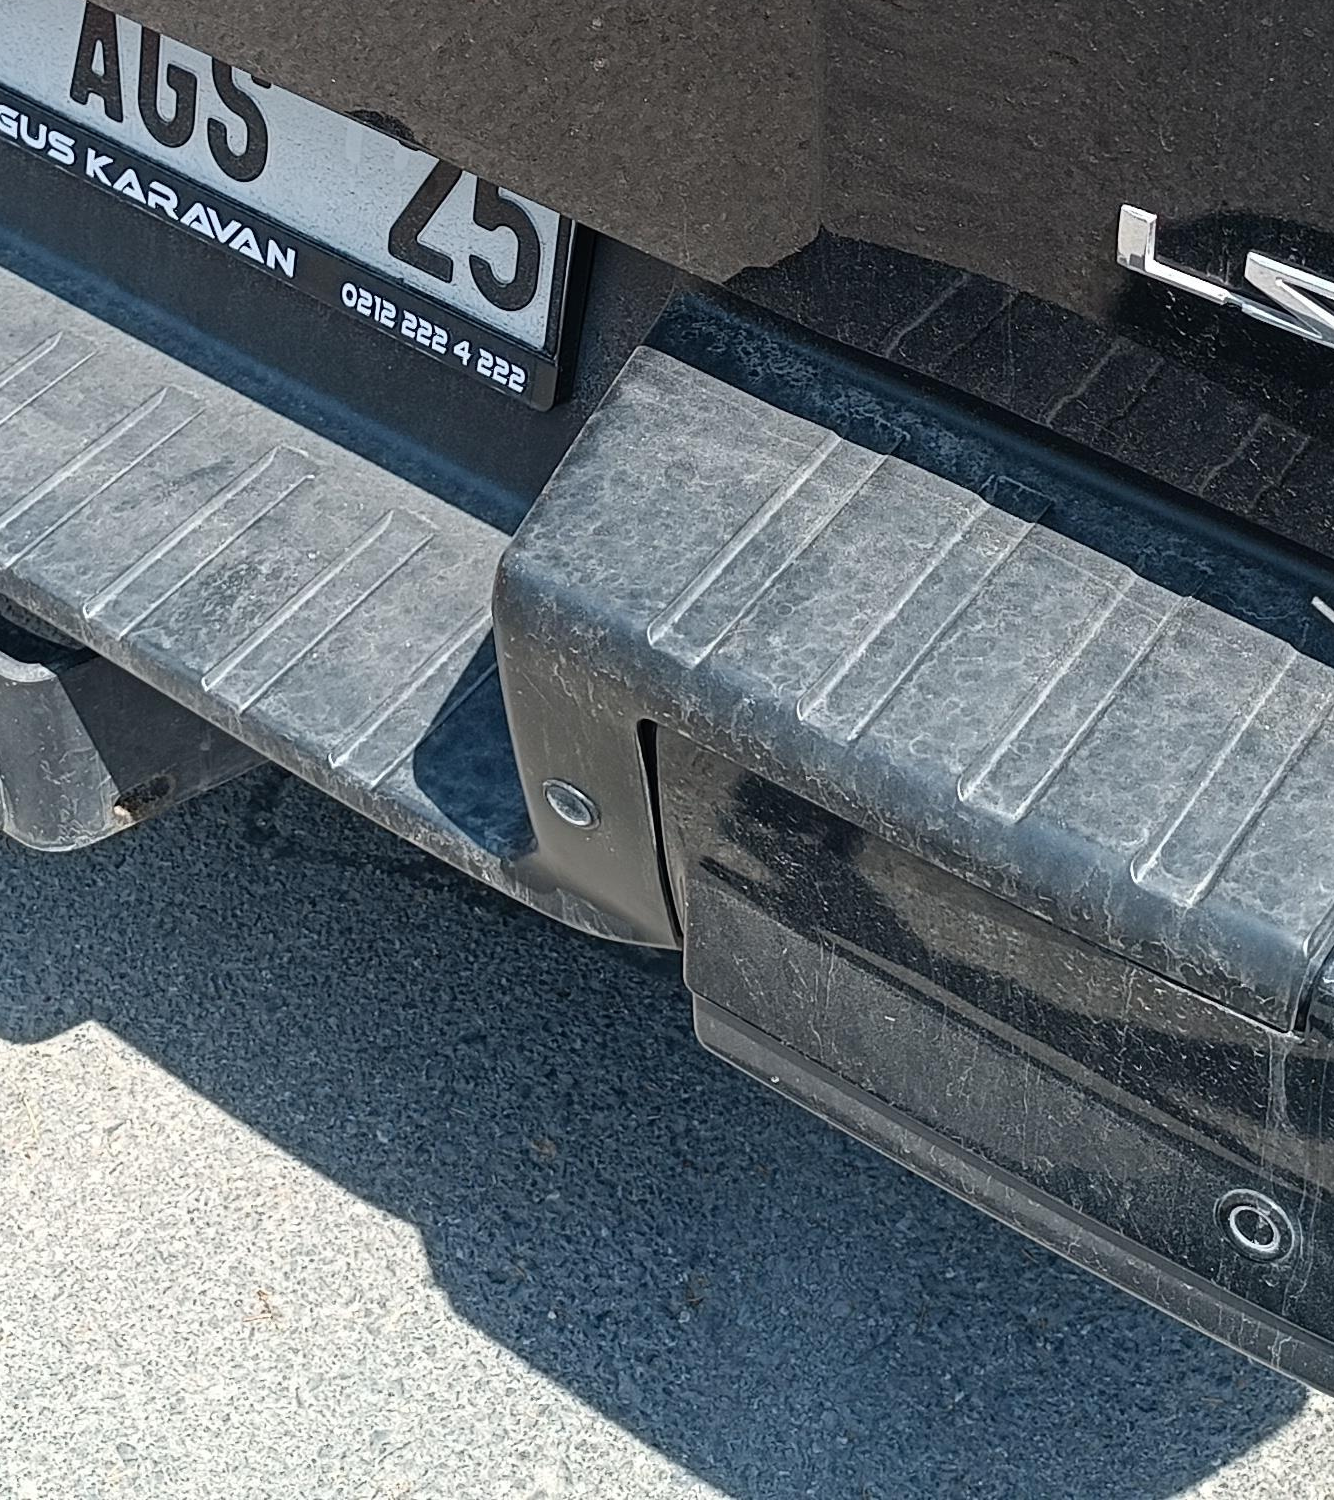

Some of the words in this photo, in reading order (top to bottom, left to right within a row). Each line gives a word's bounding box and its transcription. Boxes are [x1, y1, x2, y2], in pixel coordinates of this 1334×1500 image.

[69, 0, 271, 183] AGS
[387, 142, 541, 312] 25
[85, 147, 296, 279] KARAVAN
[340, 282, 397, 330] 0212
[400, 309, 449, 355] 222
[453, 339, 471, 367] 4
[476, 347, 528, 394] 222
